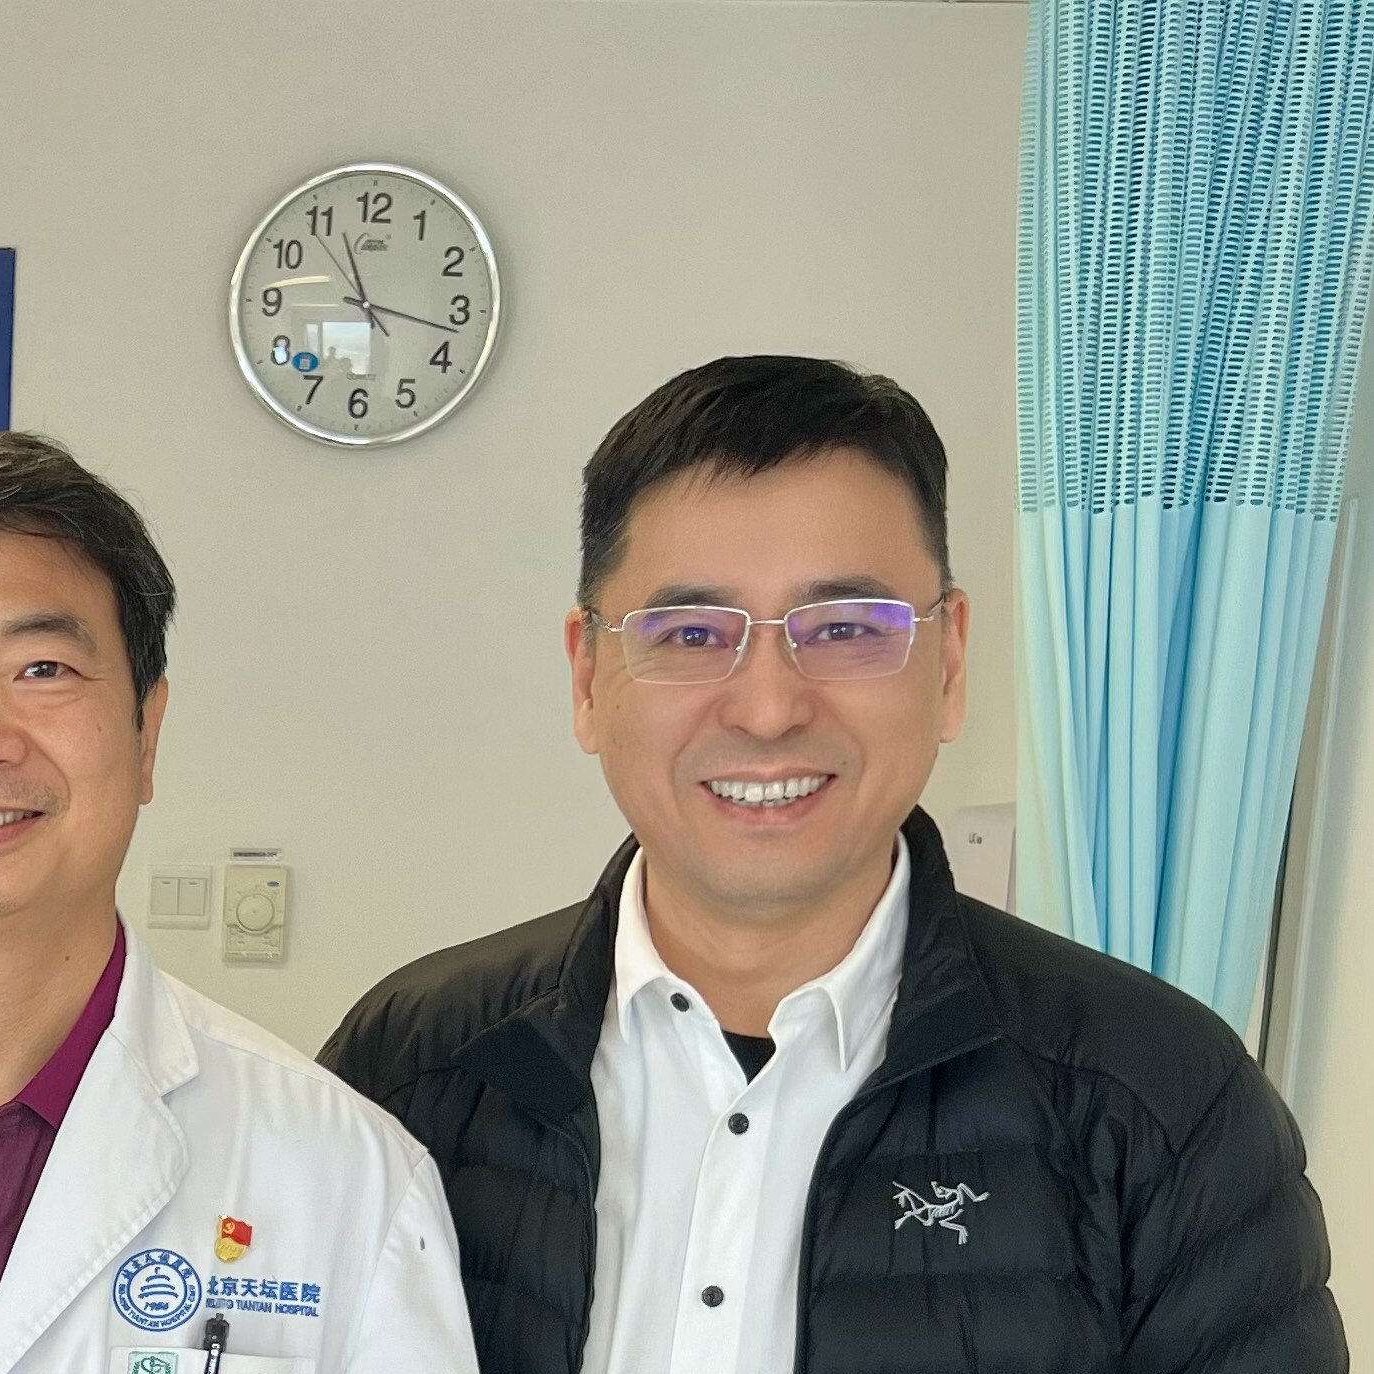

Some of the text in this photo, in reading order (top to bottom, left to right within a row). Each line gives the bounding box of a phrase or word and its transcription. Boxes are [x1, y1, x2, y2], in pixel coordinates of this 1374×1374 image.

[306, 206, 333, 236] 11
[356, 192, 393, 224] 12
[413, 210, 426, 241] 1
[273, 239, 303, 270] 10
[441, 246, 465, 277] 2
[262, 287, 282, 317] 9
[449, 295, 470, 326] 3
[271, 335, 290, 365] 8
[429, 341, 452, 373] 4
[303, 375, 324, 405] 7
[348, 388, 369, 419] 6
[395, 378, 416, 409] 5
[207, 1276, 321, 1304] 北京天坛医院
